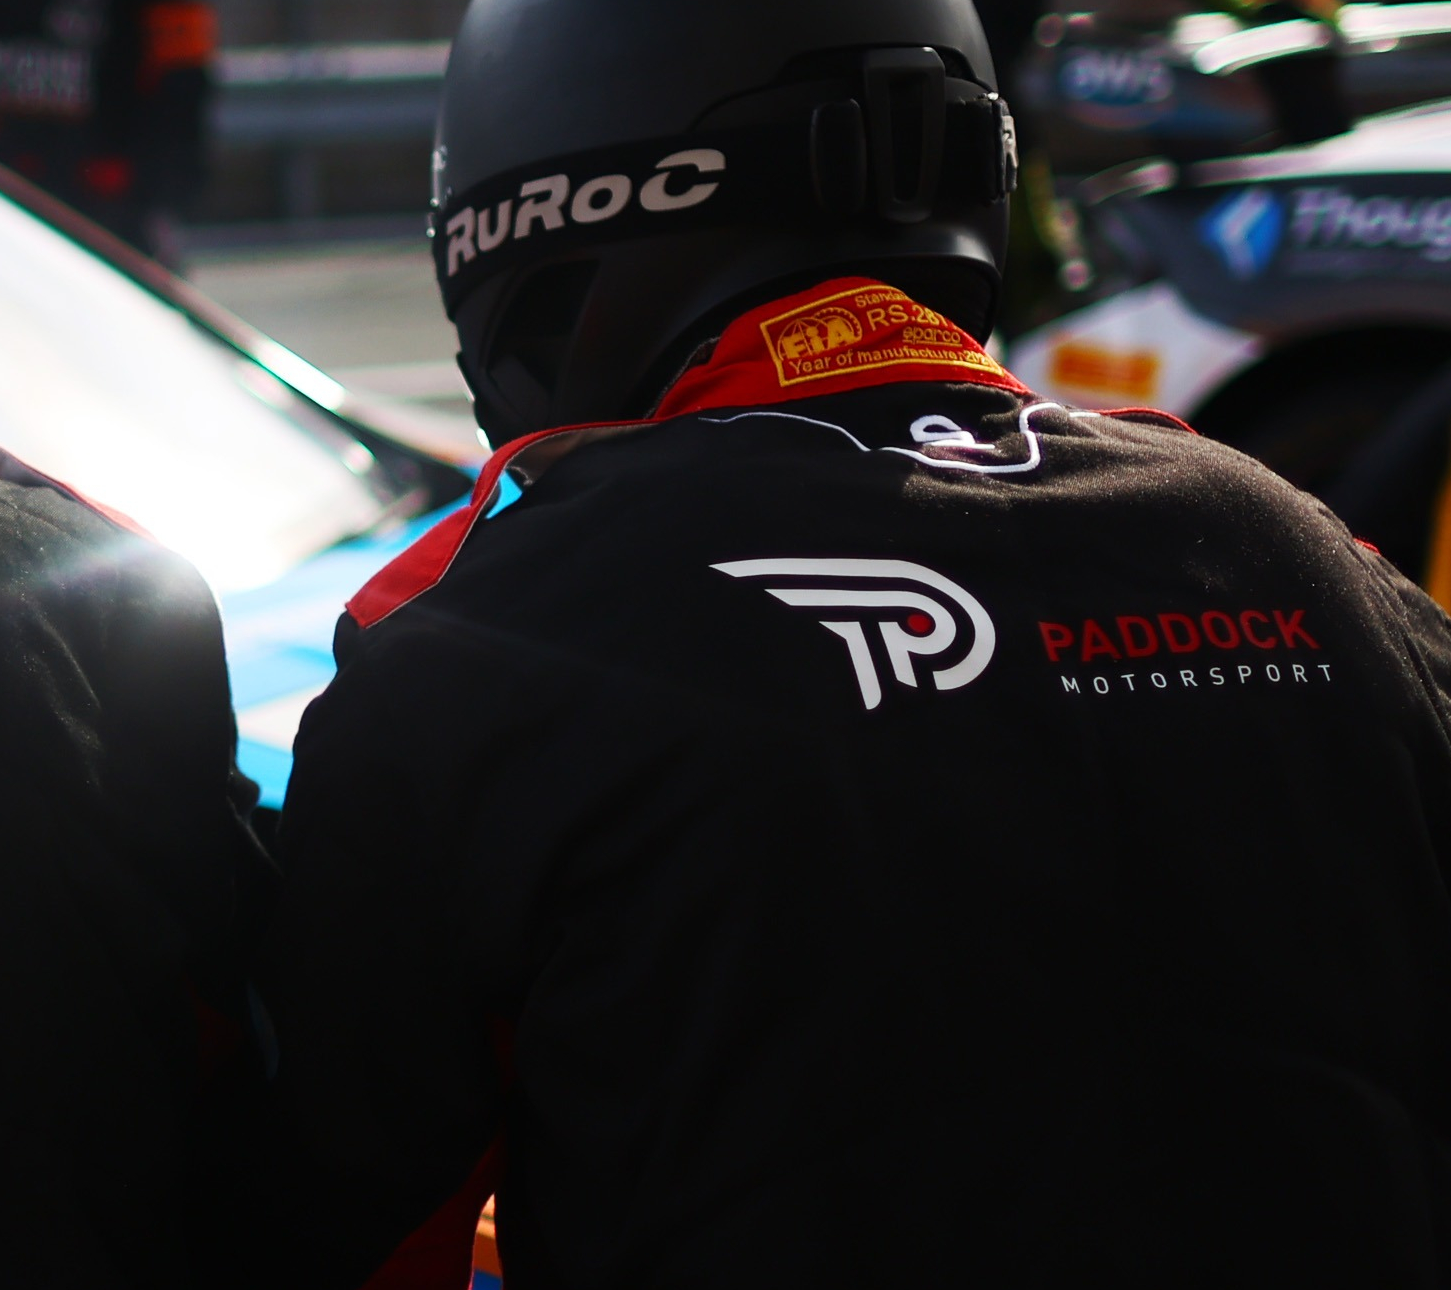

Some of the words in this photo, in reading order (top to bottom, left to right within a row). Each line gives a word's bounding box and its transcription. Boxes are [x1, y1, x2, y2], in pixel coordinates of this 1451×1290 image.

[902, 325, 962, 346] sparco
[789, 355, 831, 375] Year
[837, 349, 853, 366] of
[1037, 609, 1321, 662] PADDOCK
[1061, 663, 1334, 695] MOTORSPORT
